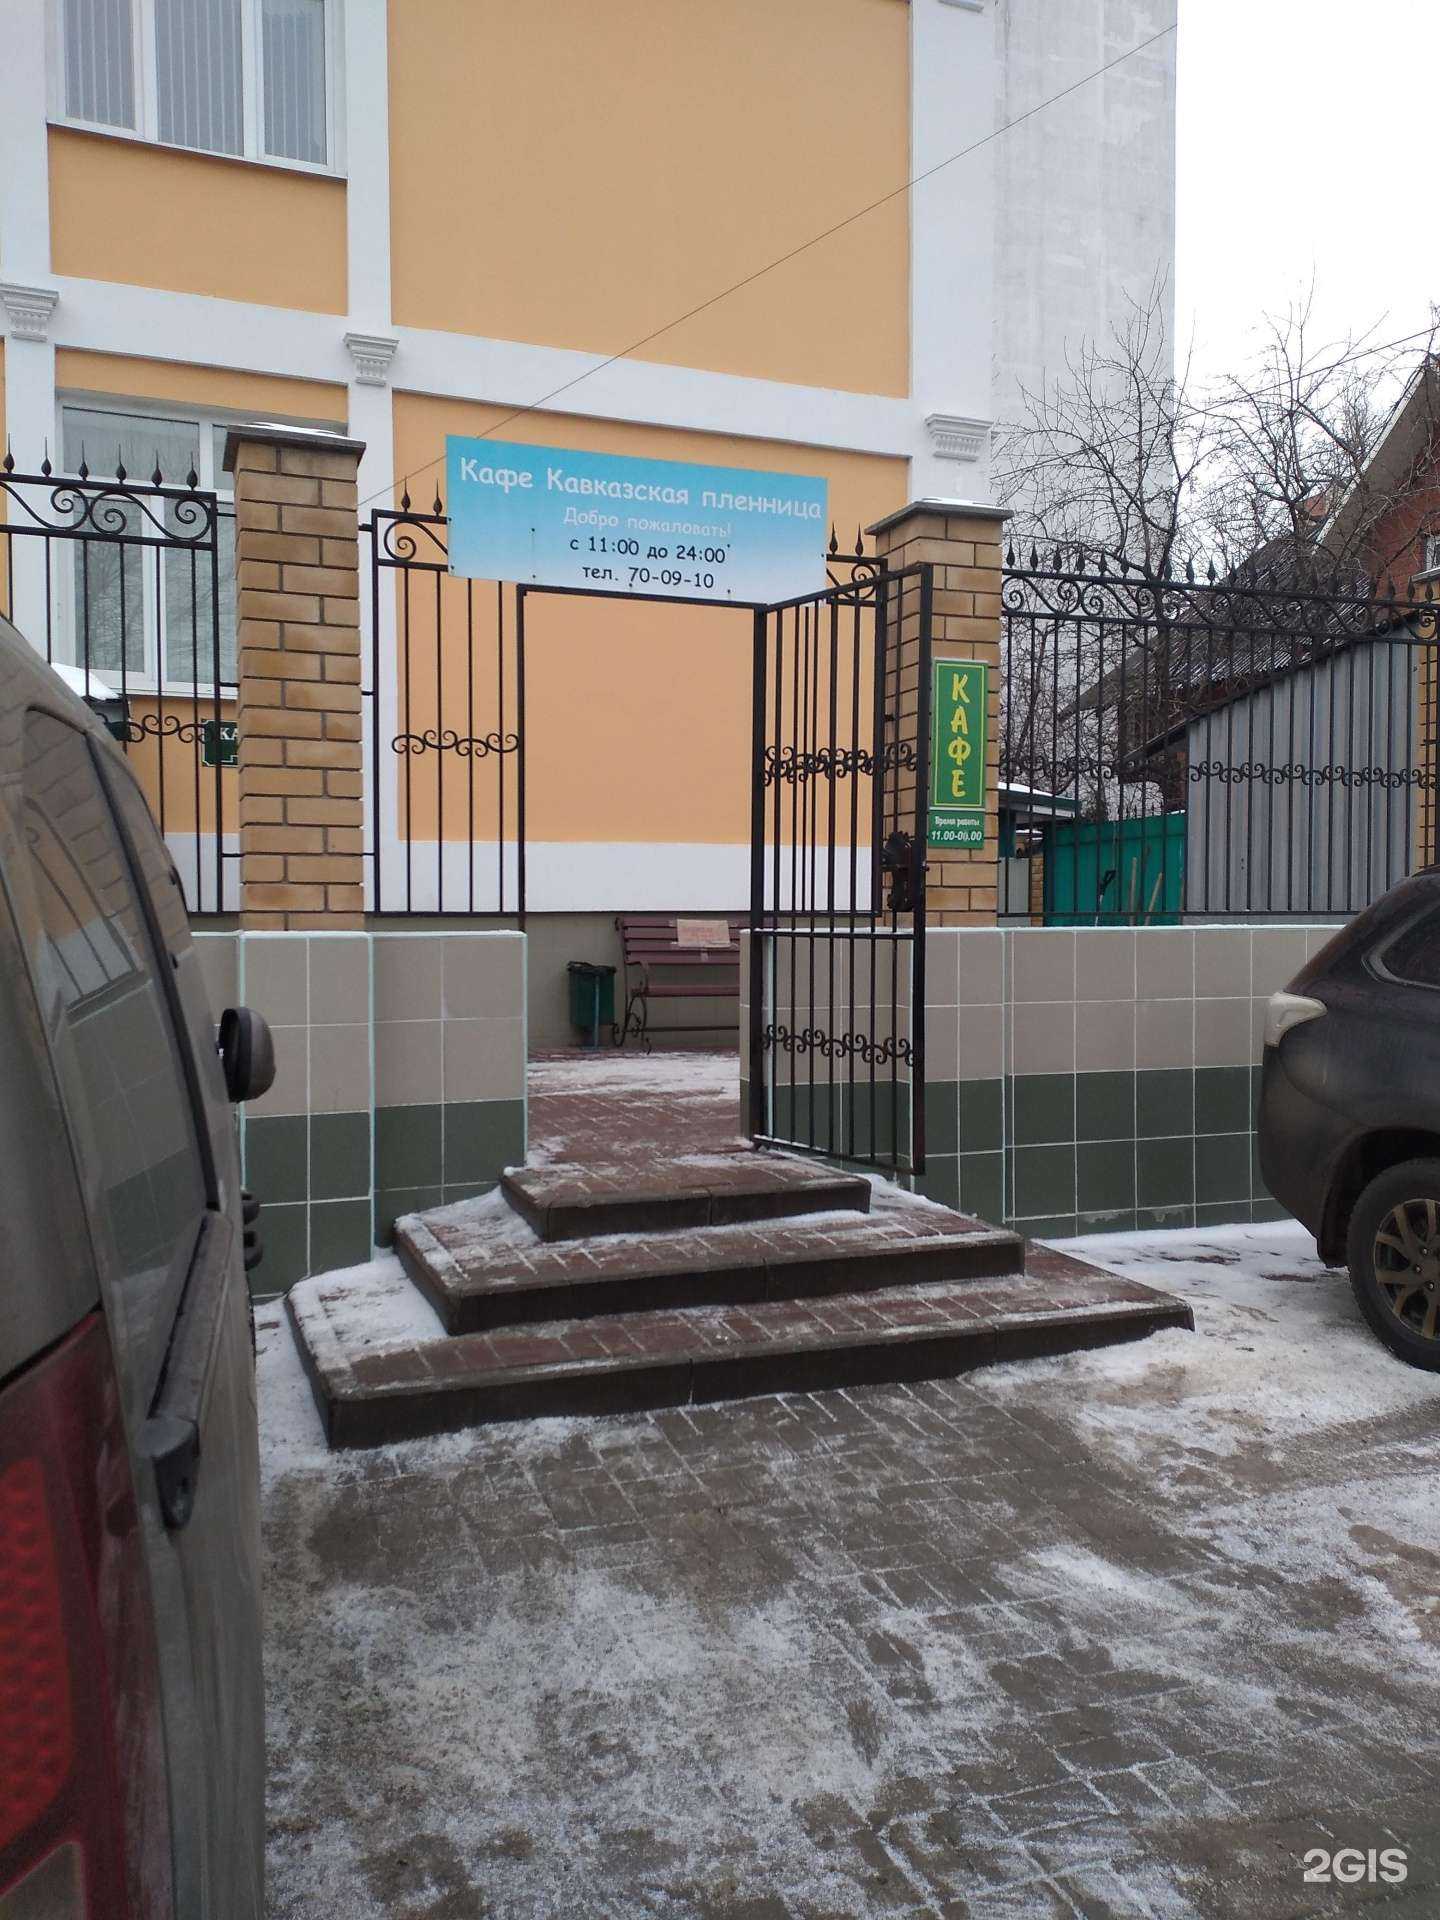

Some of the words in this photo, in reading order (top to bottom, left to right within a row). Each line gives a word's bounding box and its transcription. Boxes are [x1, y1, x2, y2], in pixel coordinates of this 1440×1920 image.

[460, 457, 533, 492] Кафе
[547, 467, 689, 505] Кавказская
[702, 491, 822, 519] пленница
[564, 507, 620, 530] Добро
[627, 515, 732, 539] пожаловать!
[570, 539, 580, 553] с
[589, 536, 639, 556] 11:00
[647, 545, 668, 560] до
[676, 545, 727, 564] 24:00
[582, 566, 618, 581] тел.
[629, 567, 714, 589] 70-09-10
[948, 673, 971, 798] КАФЕ
